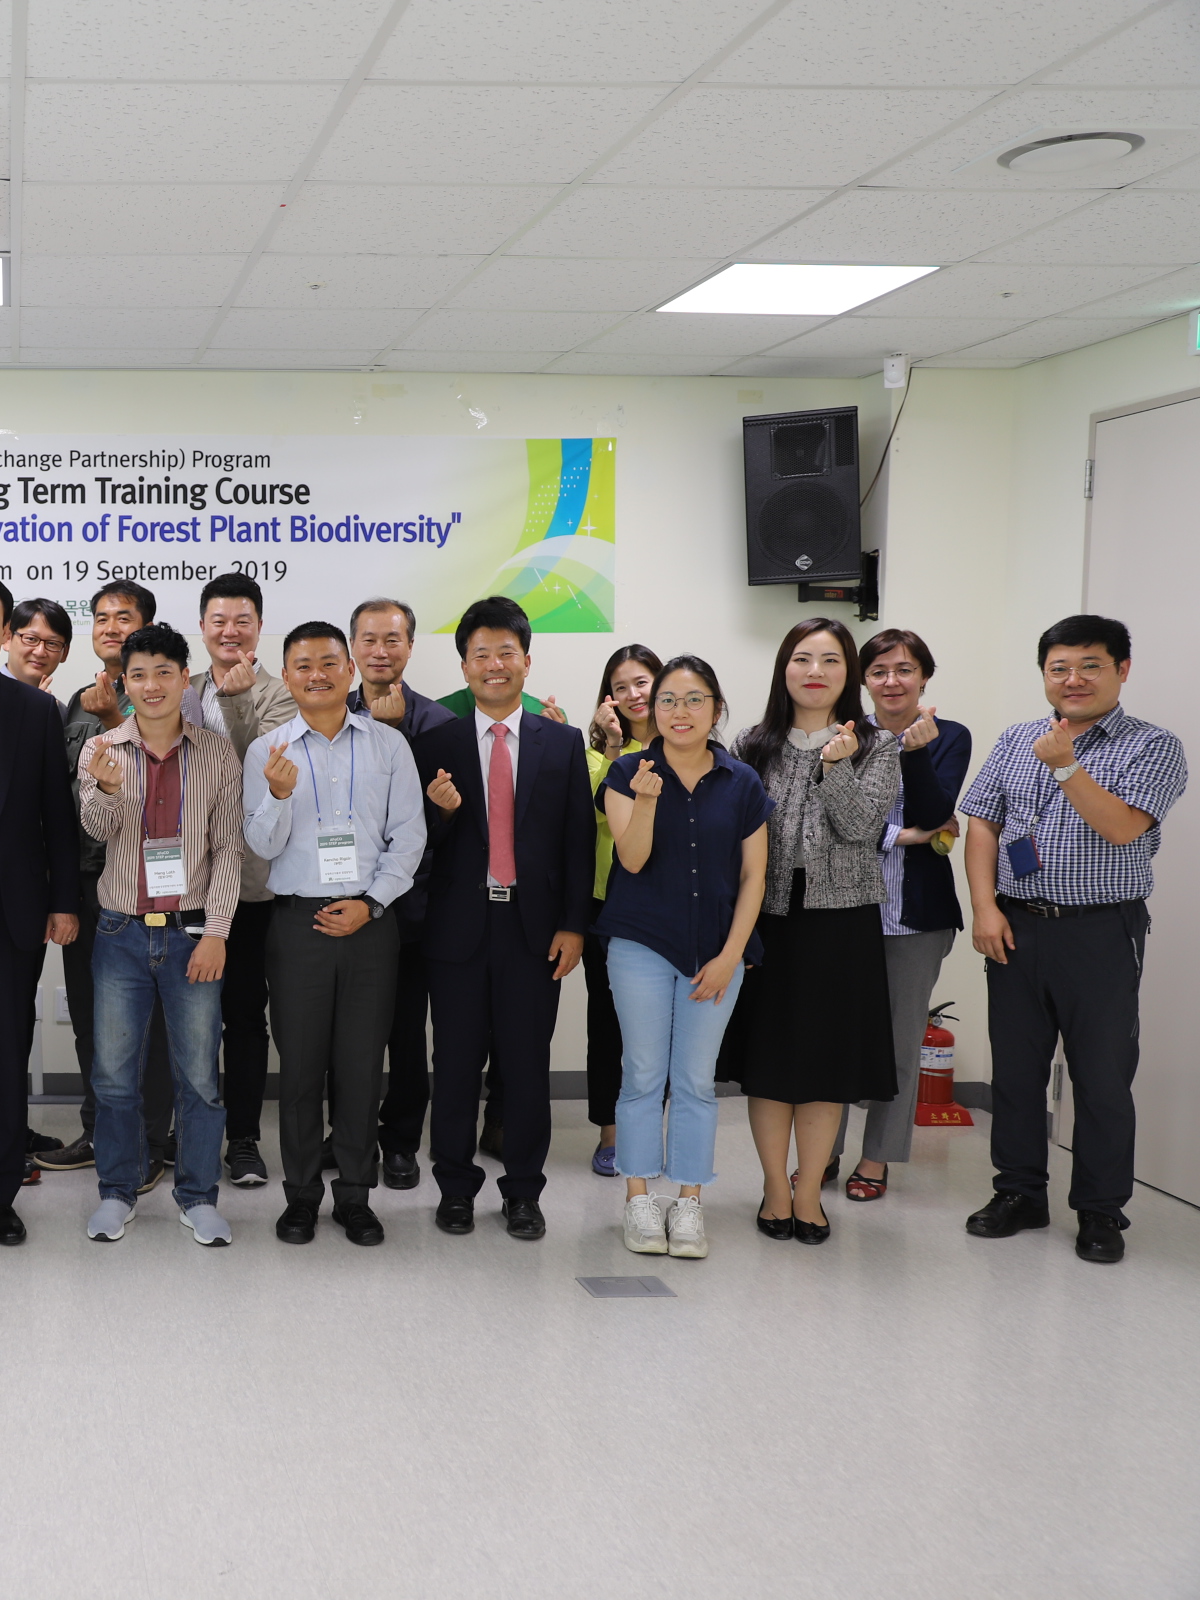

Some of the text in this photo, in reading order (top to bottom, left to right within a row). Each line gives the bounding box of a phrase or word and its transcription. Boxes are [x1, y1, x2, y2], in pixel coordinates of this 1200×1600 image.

[69, 448, 186, 473] Partnership)
[192, 450, 271, 473] Program
[17, 476, 86, 505] Term
[94, 476, 209, 510] Training
[215, 476, 311, 505] Course
[82, 513, 111, 543] of
[118, 515, 201, 543] Forest
[210, 514, 282, 543] Plant
[290, 512, 462, 549] Biodiversity"
[26, 565, 53, 581] on
[63, 560, 89, 582] 19
[96, 559, 217, 582] September
[230, 560, 288, 582] 2019
